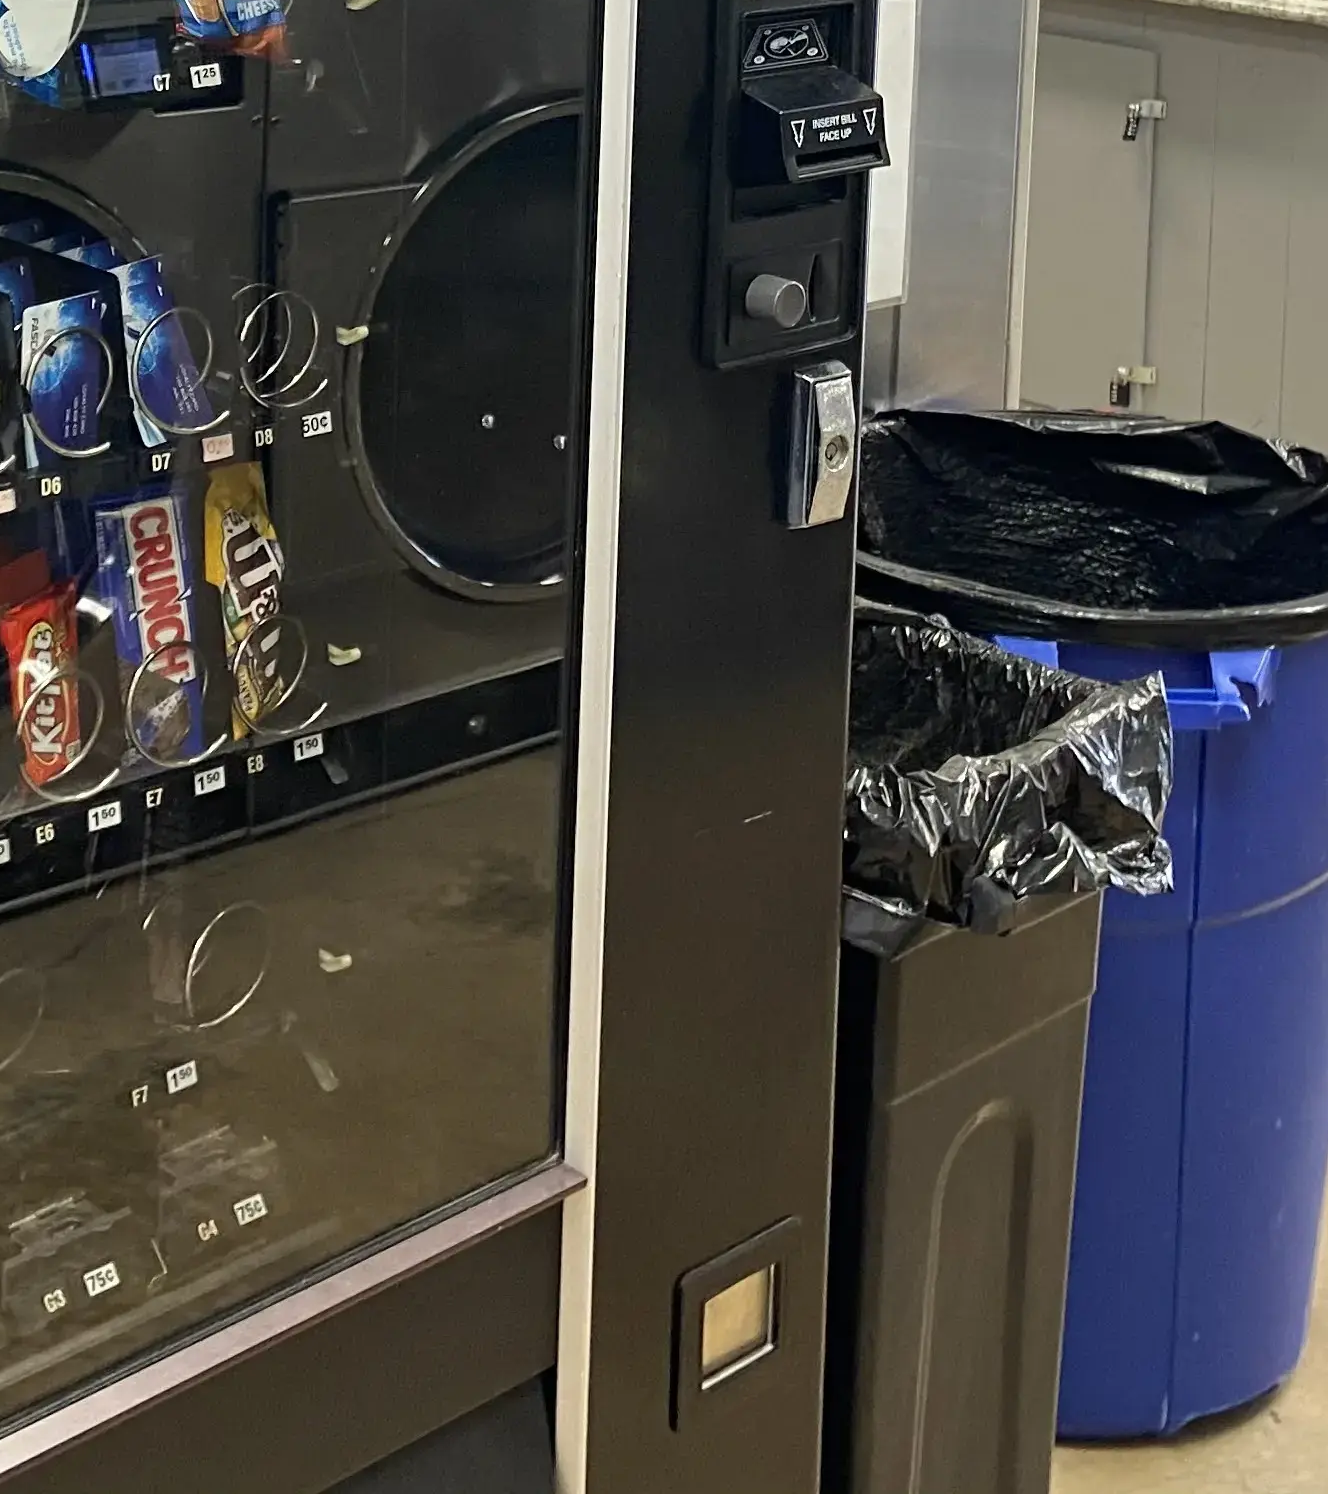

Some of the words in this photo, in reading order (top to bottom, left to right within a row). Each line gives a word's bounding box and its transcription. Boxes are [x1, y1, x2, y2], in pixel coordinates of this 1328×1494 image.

[154, 74, 170, 92] C7
[812, 116, 840, 129] INSERT
[841, 113, 857, 126] BILL
[819, 131, 839, 143] FACE
[840, 128, 852, 141] UP
[256, 428, 273, 446] D8
[303, 415, 329, 434] 50¢
[152, 453, 171, 471] D7
[41, 476, 62, 496] D6
[130, 506, 190, 683] CRUNCH
[247, 755, 264, 774] E8
[146, 788, 163, 807] E7
[36, 824, 54, 844] E6
[132, 1085, 149, 1107] F7
[199, 1220, 218, 1242] G4
[45, 1289, 66, 1313] G3
